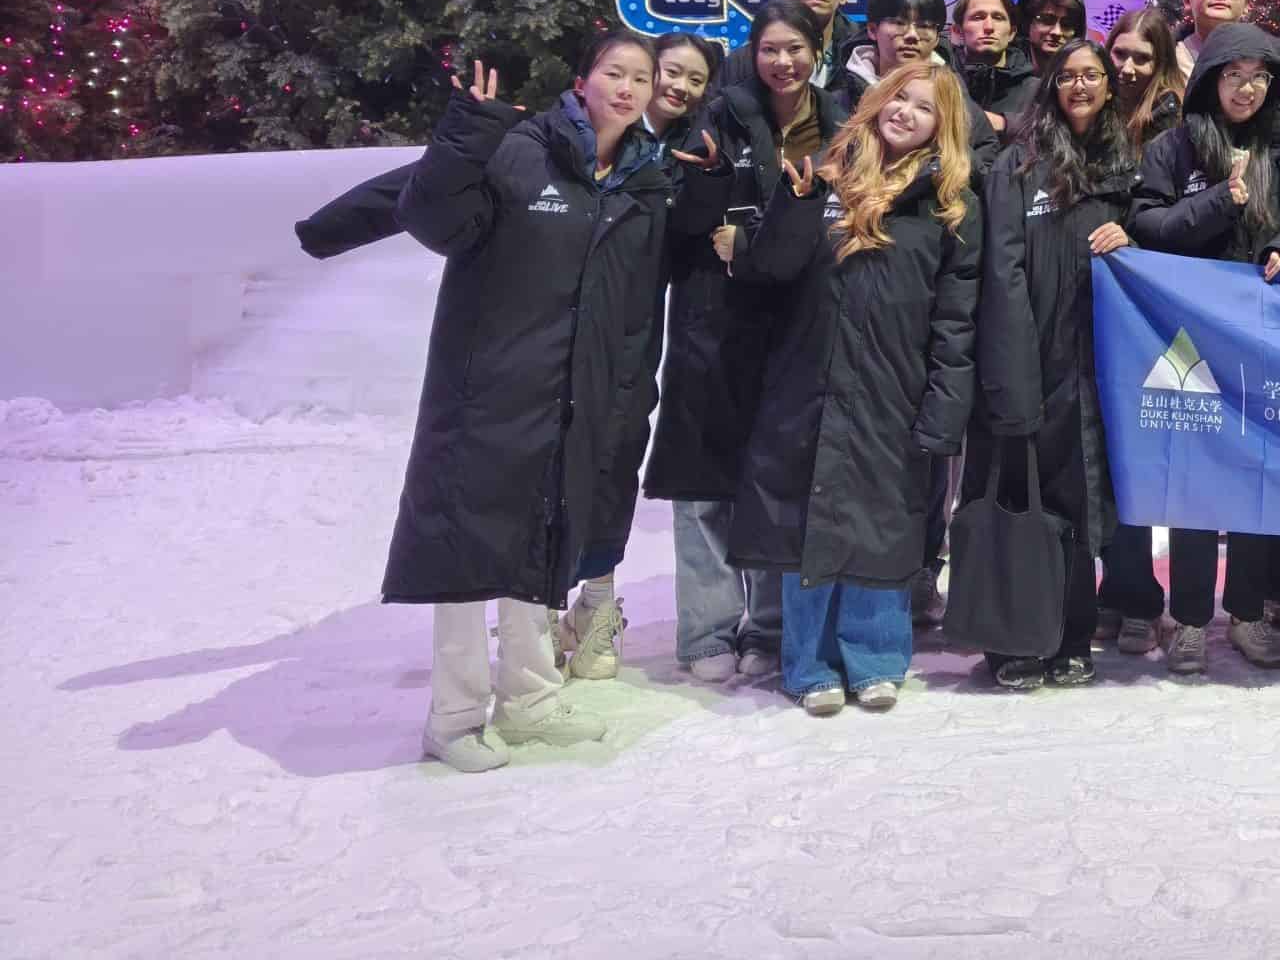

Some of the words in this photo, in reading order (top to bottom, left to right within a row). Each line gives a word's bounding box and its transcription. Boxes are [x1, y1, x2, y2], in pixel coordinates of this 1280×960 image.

[1141, 394, 1222, 412] 昆山杜克大学
[1141, 410, 1169, 420] DUKE
[1172, 411, 1222, 425] KUNSHAN
[1140, 419, 1222, 433] UNIVERSITY
